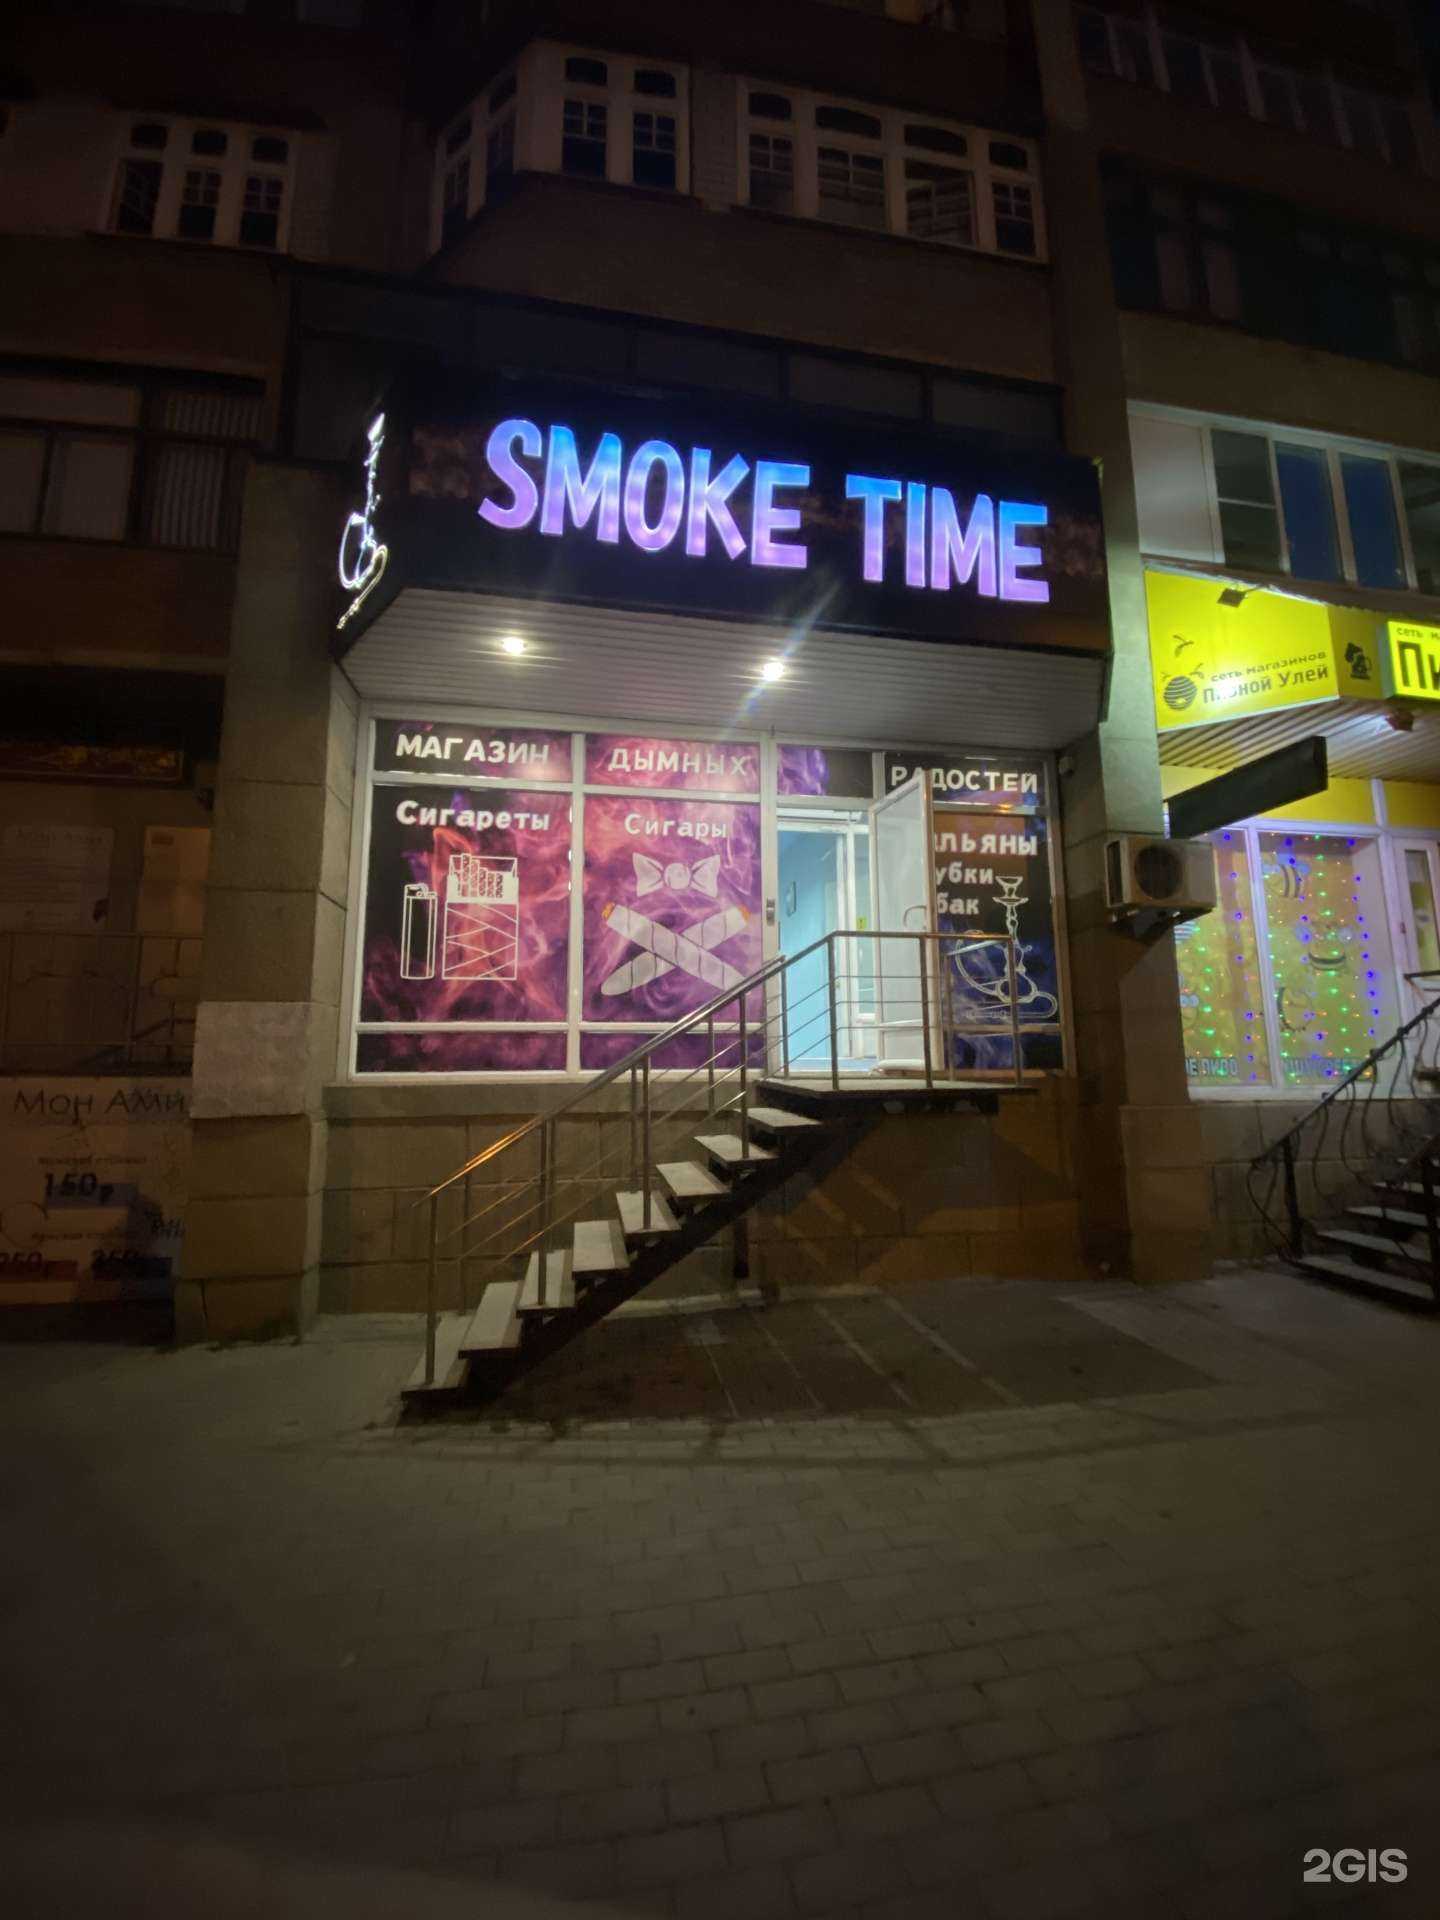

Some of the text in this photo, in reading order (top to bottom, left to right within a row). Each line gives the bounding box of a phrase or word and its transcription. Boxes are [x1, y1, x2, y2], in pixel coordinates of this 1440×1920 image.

[478, 418, 1050, 603] SMOKE TIME
[1211, 650, 1327, 683] сеть магазинов
[1203, 664, 1330, 703] Пной Улей
[395, 733, 550, 765] МАГАЗИН
[607, 747, 748, 776] ДЫМНЫХ
[395, 799, 550, 832] Сигареты
[623, 812, 728, 840] Сигары
[934, 832, 1038, 856] льяны
[936, 861, 994, 885] убки
[937, 892, 980, 915] бак
